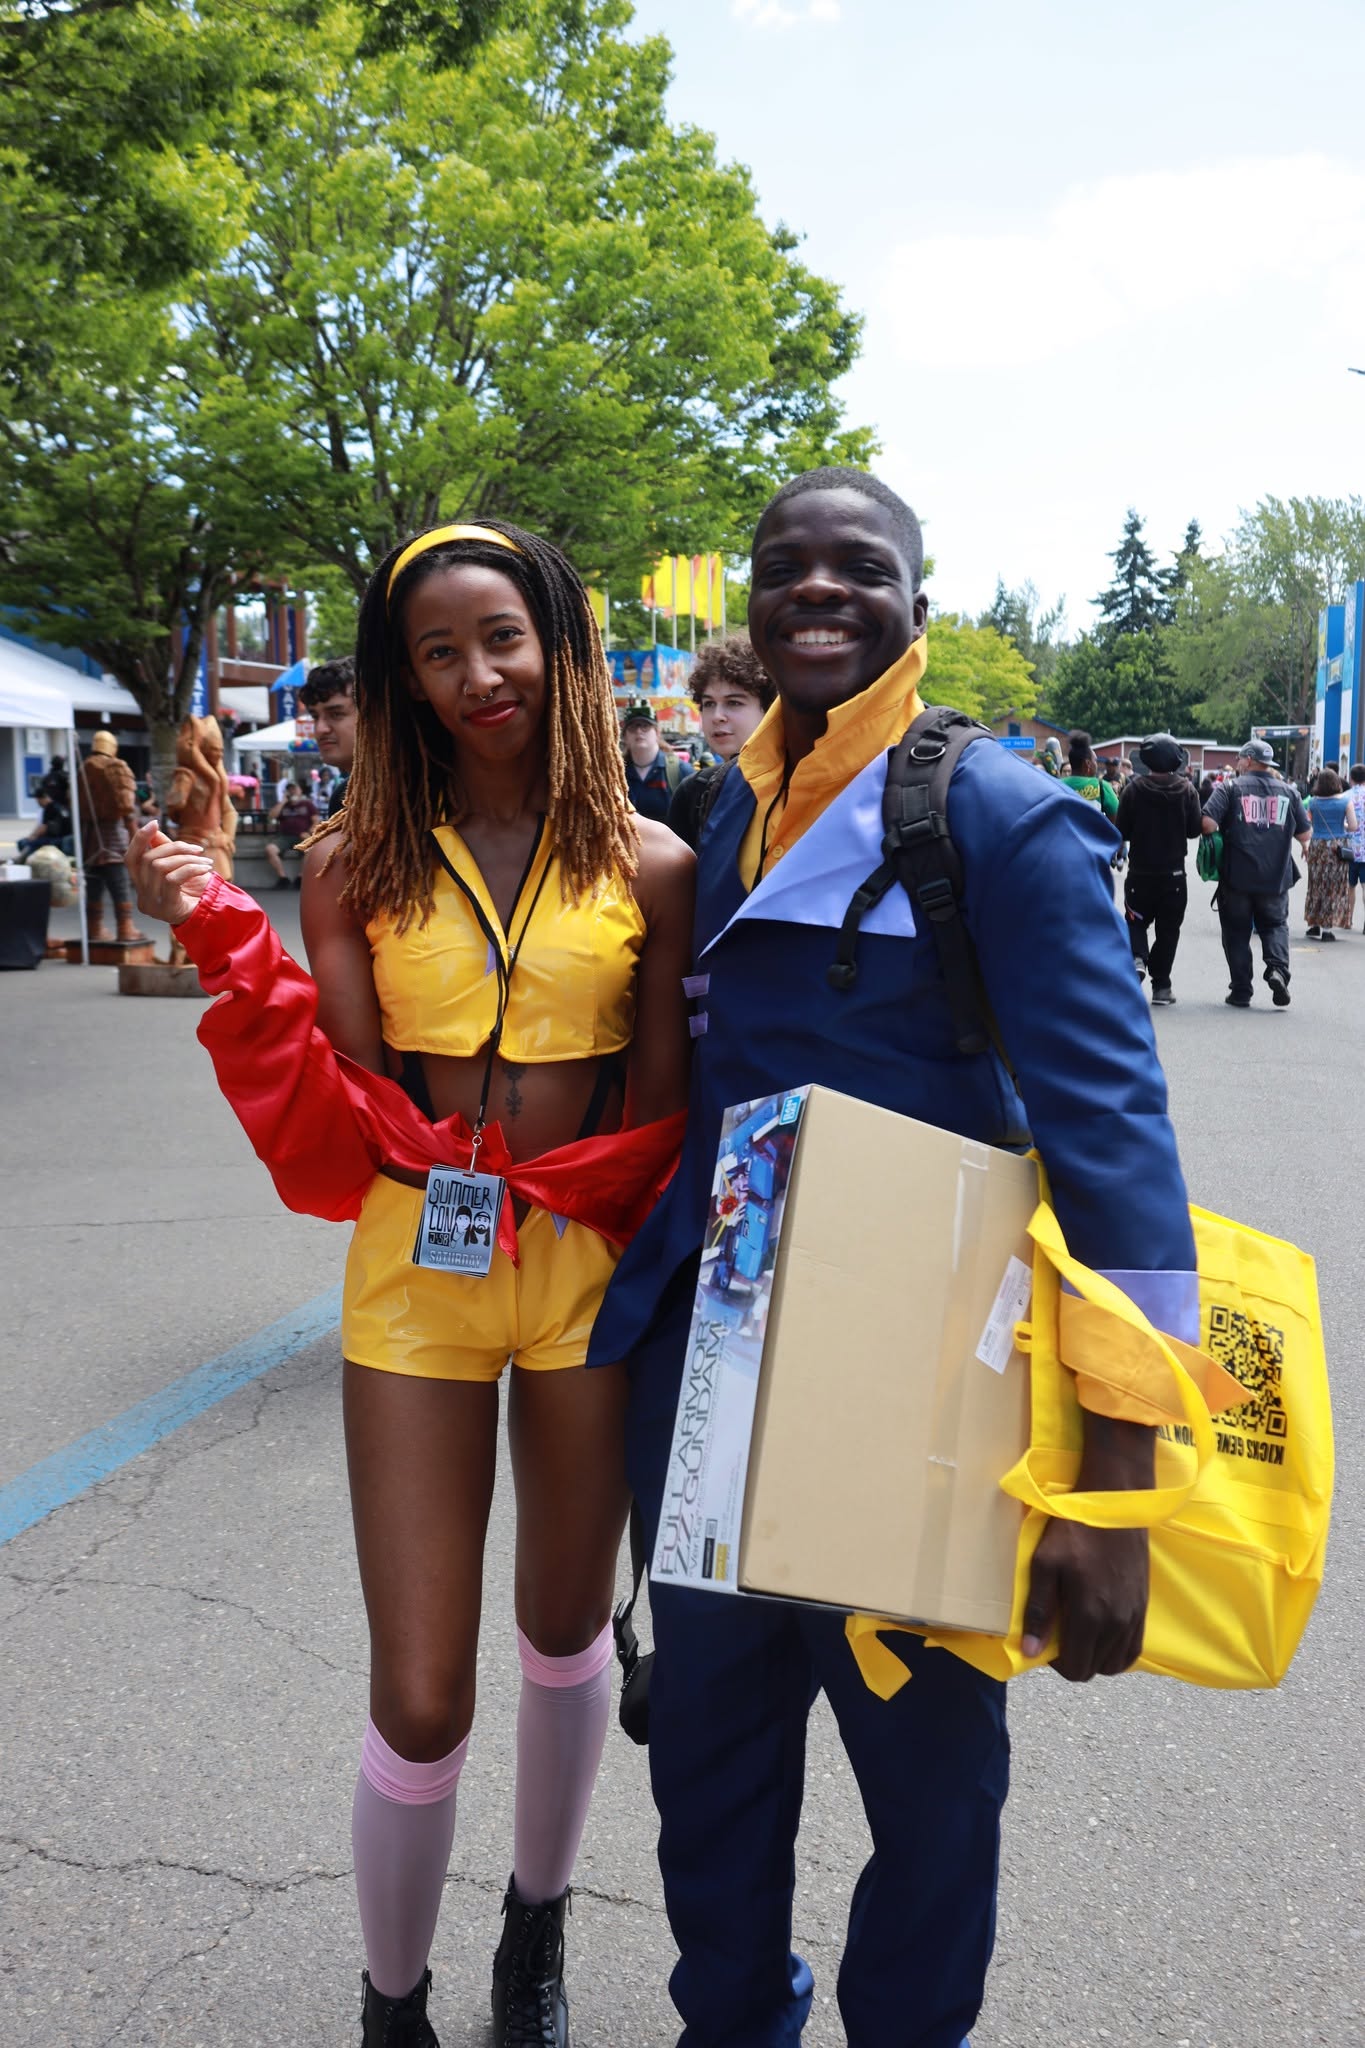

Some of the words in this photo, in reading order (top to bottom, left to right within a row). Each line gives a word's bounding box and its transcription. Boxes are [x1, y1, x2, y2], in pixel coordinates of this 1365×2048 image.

[1243, 798, 1287, 822] COMET
[428, 1178, 492, 1210] SUMMER
[429, 1204, 455, 1232] CON
[428, 1250, 482, 1269] SATURDAY
[683, 1320, 723, 1505] GUNDAM
[659, 1479, 686, 1576] FULL
[677, 1319, 711, 1470] ARMOR
[1247, 1441, 1285, 1465] KICKS
